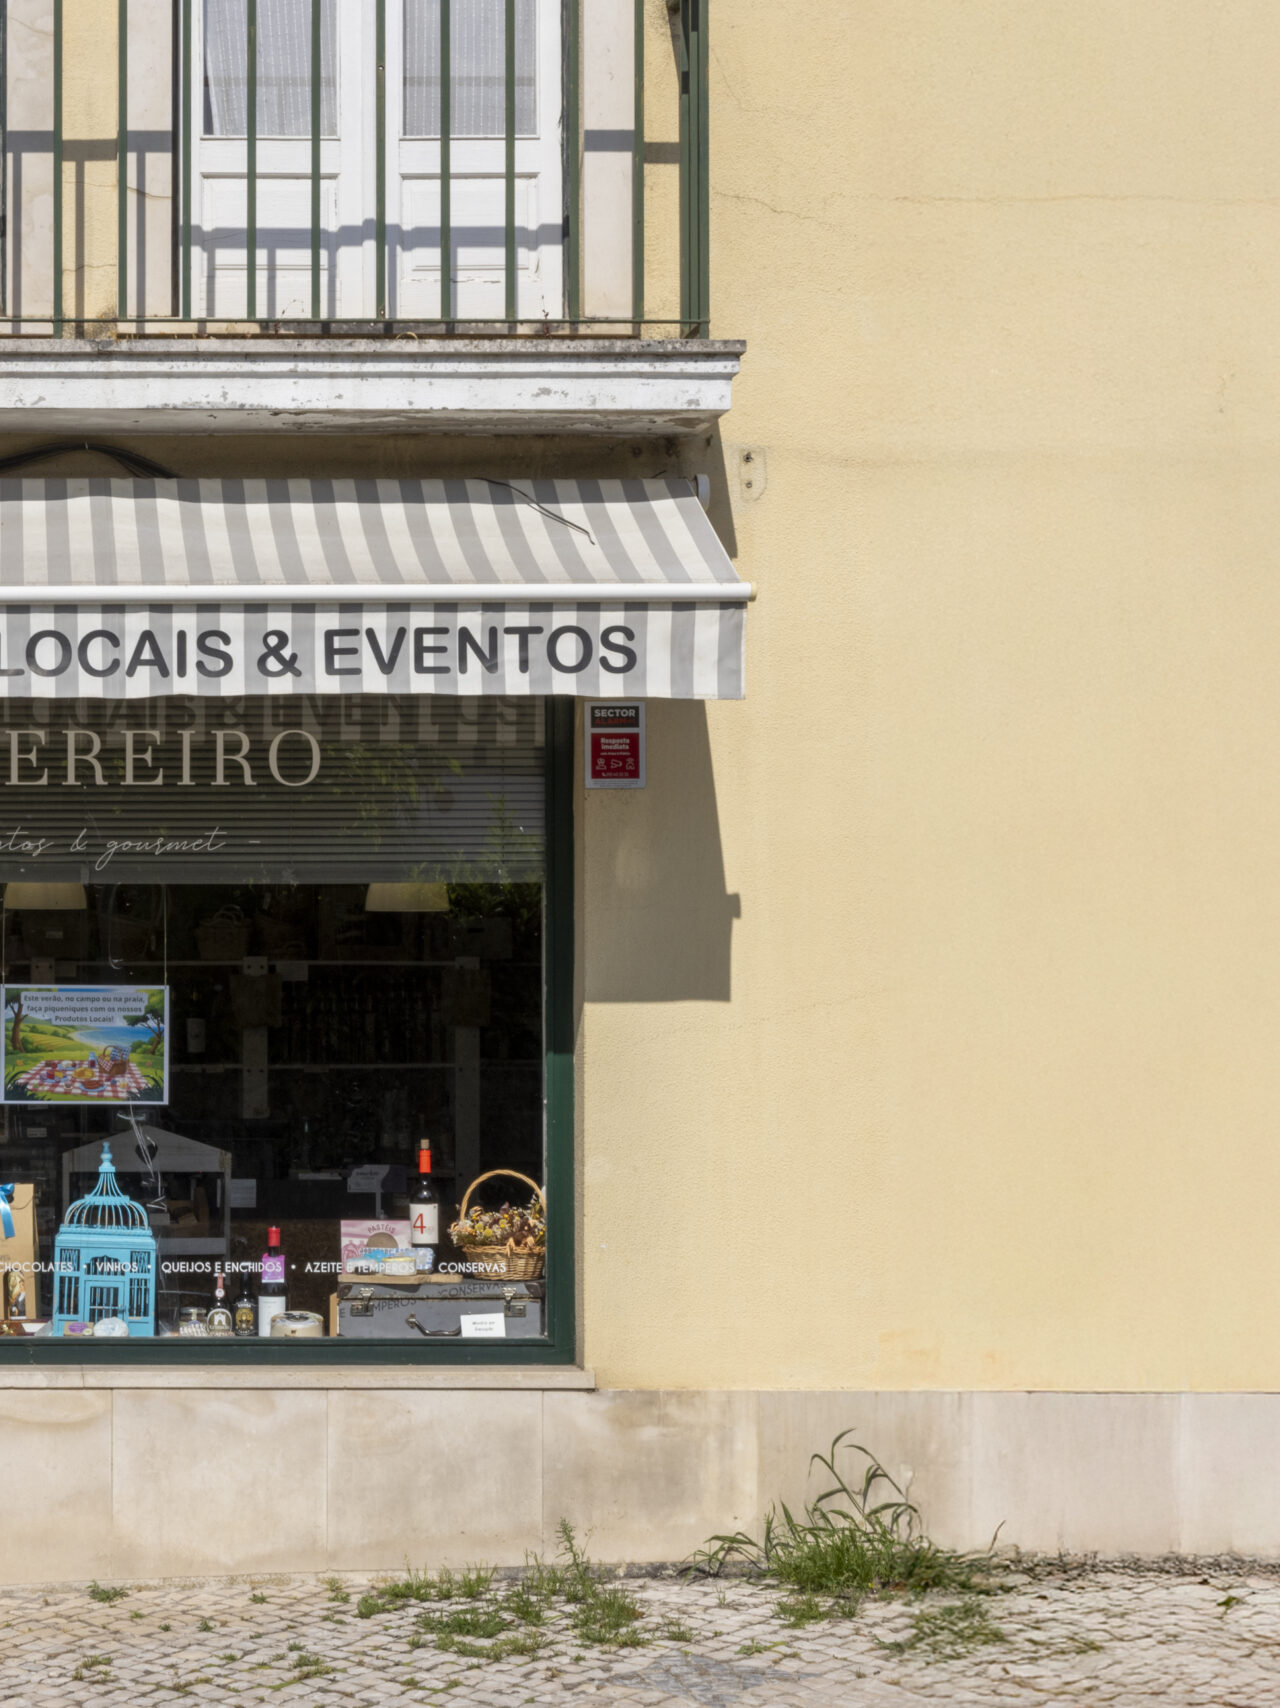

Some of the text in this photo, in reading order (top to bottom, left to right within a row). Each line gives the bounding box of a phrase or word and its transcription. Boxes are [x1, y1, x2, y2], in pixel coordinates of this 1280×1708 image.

[256, 628, 302, 678] &
[324, 625, 638, 678] EVENTOS
[594, 709, 636, 717] SECTOR
[95, 826, 228, 871] gourmet
[75, 996, 101, 1004] campo
[44, 1005, 88, 1013] piqueniques
[412, 1213, 427, 1234] 4
[95, 1261, 139, 1273] VINHOS
[161, 1261, 212, 1273] QUEIJOS
[214, 1261, 222, 1273] E
[224, 1261, 282, 1273] ENCHIDOS
[304, 1261, 342, 1273] AZEITE
[357, 1261, 416, 1273] TEMPEROS
[438, 1261, 507, 1273] CONSERVAS
